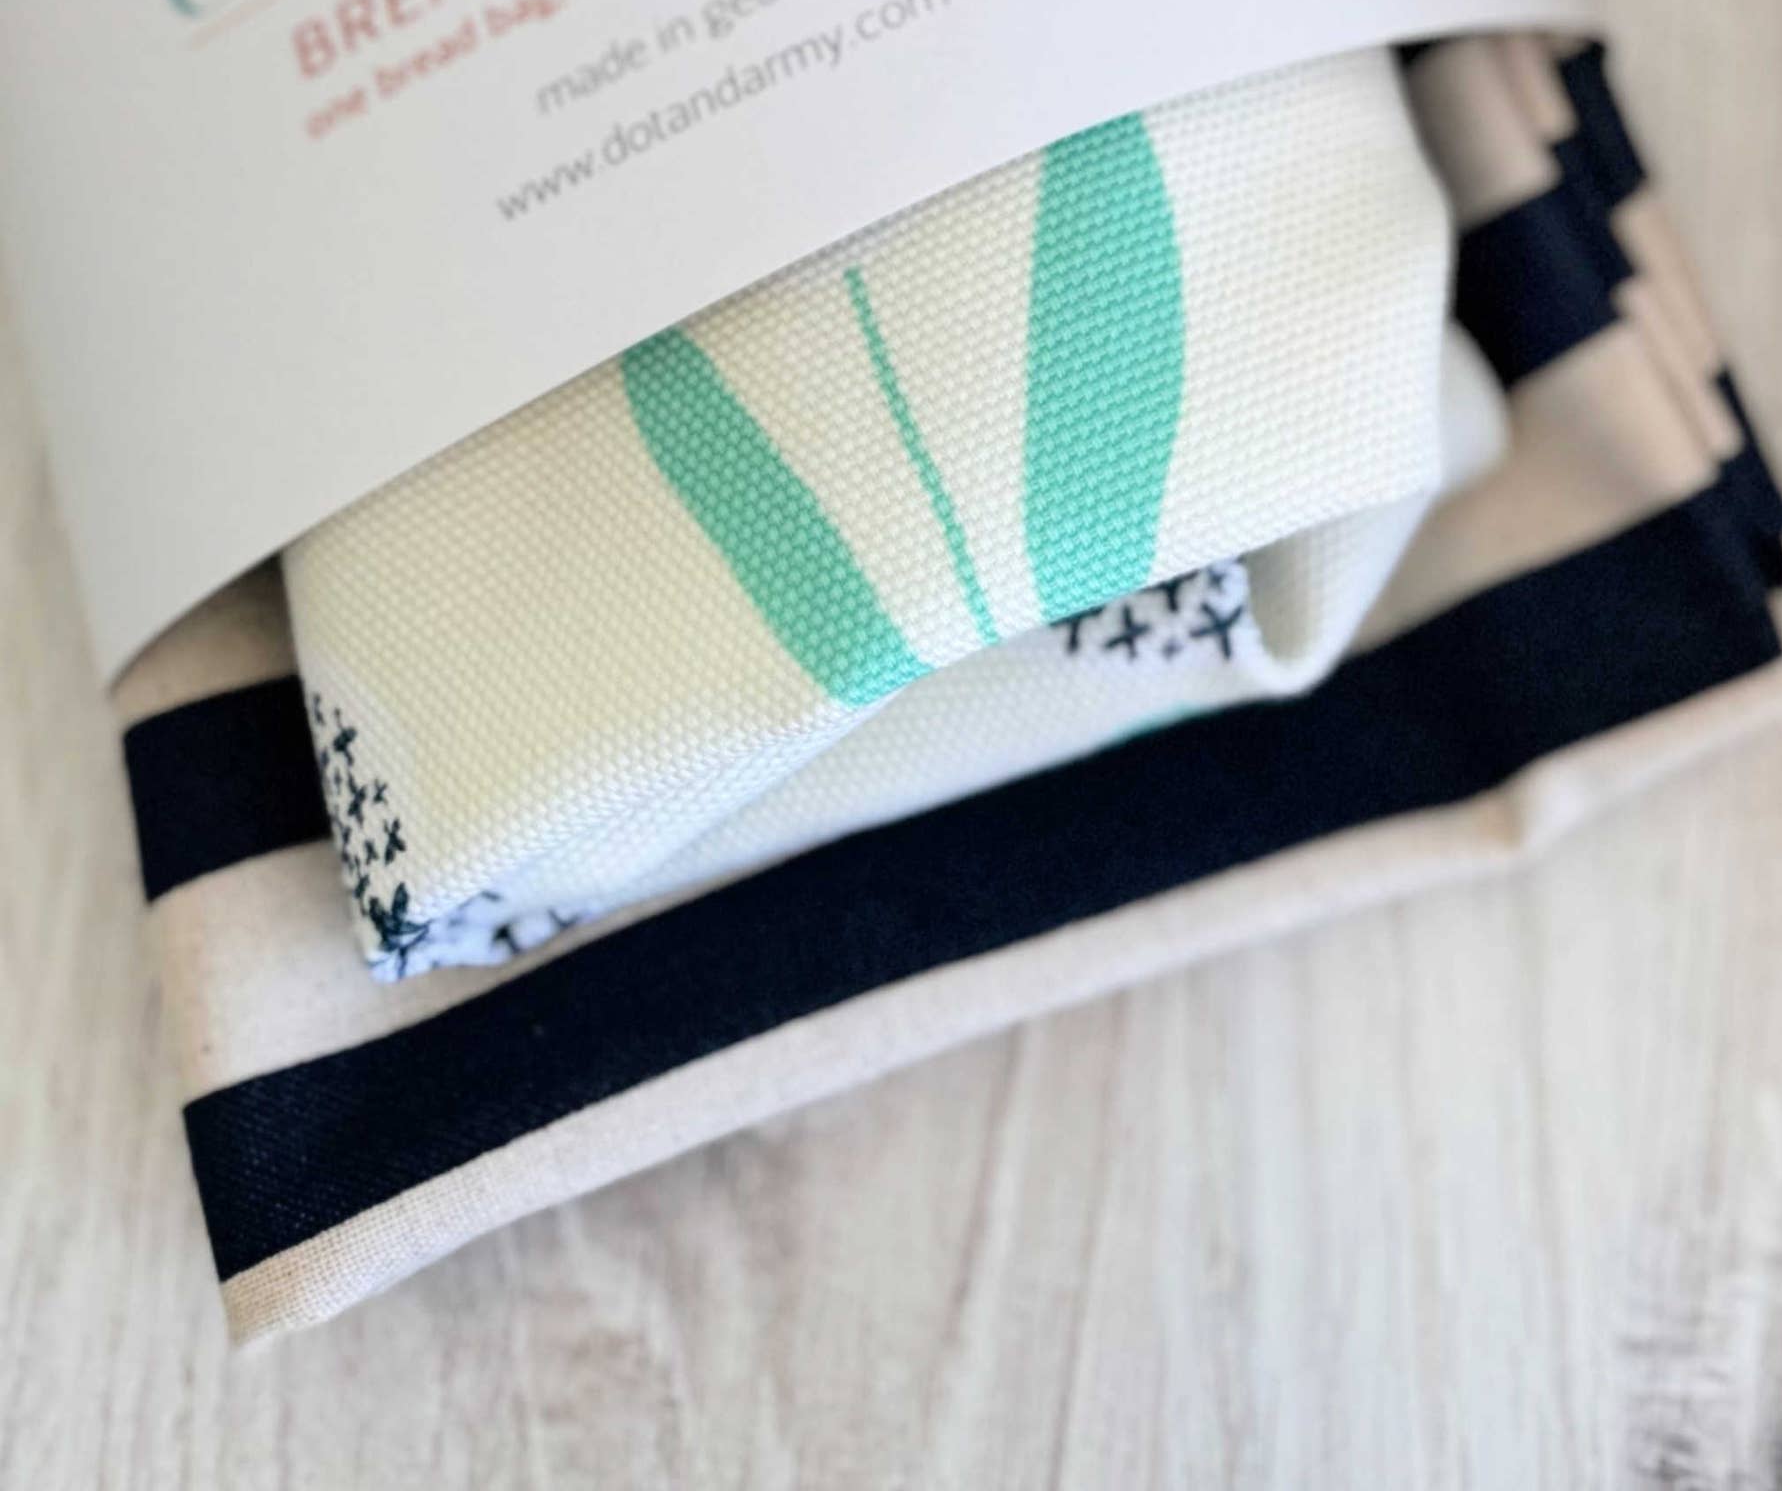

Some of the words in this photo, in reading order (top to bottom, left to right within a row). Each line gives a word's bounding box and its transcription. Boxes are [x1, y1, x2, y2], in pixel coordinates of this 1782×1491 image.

[306, 84, 368, 142] one
[372, 16, 479, 100] bread
[535, 36, 650, 115] made
[656, 11, 697, 54] in
